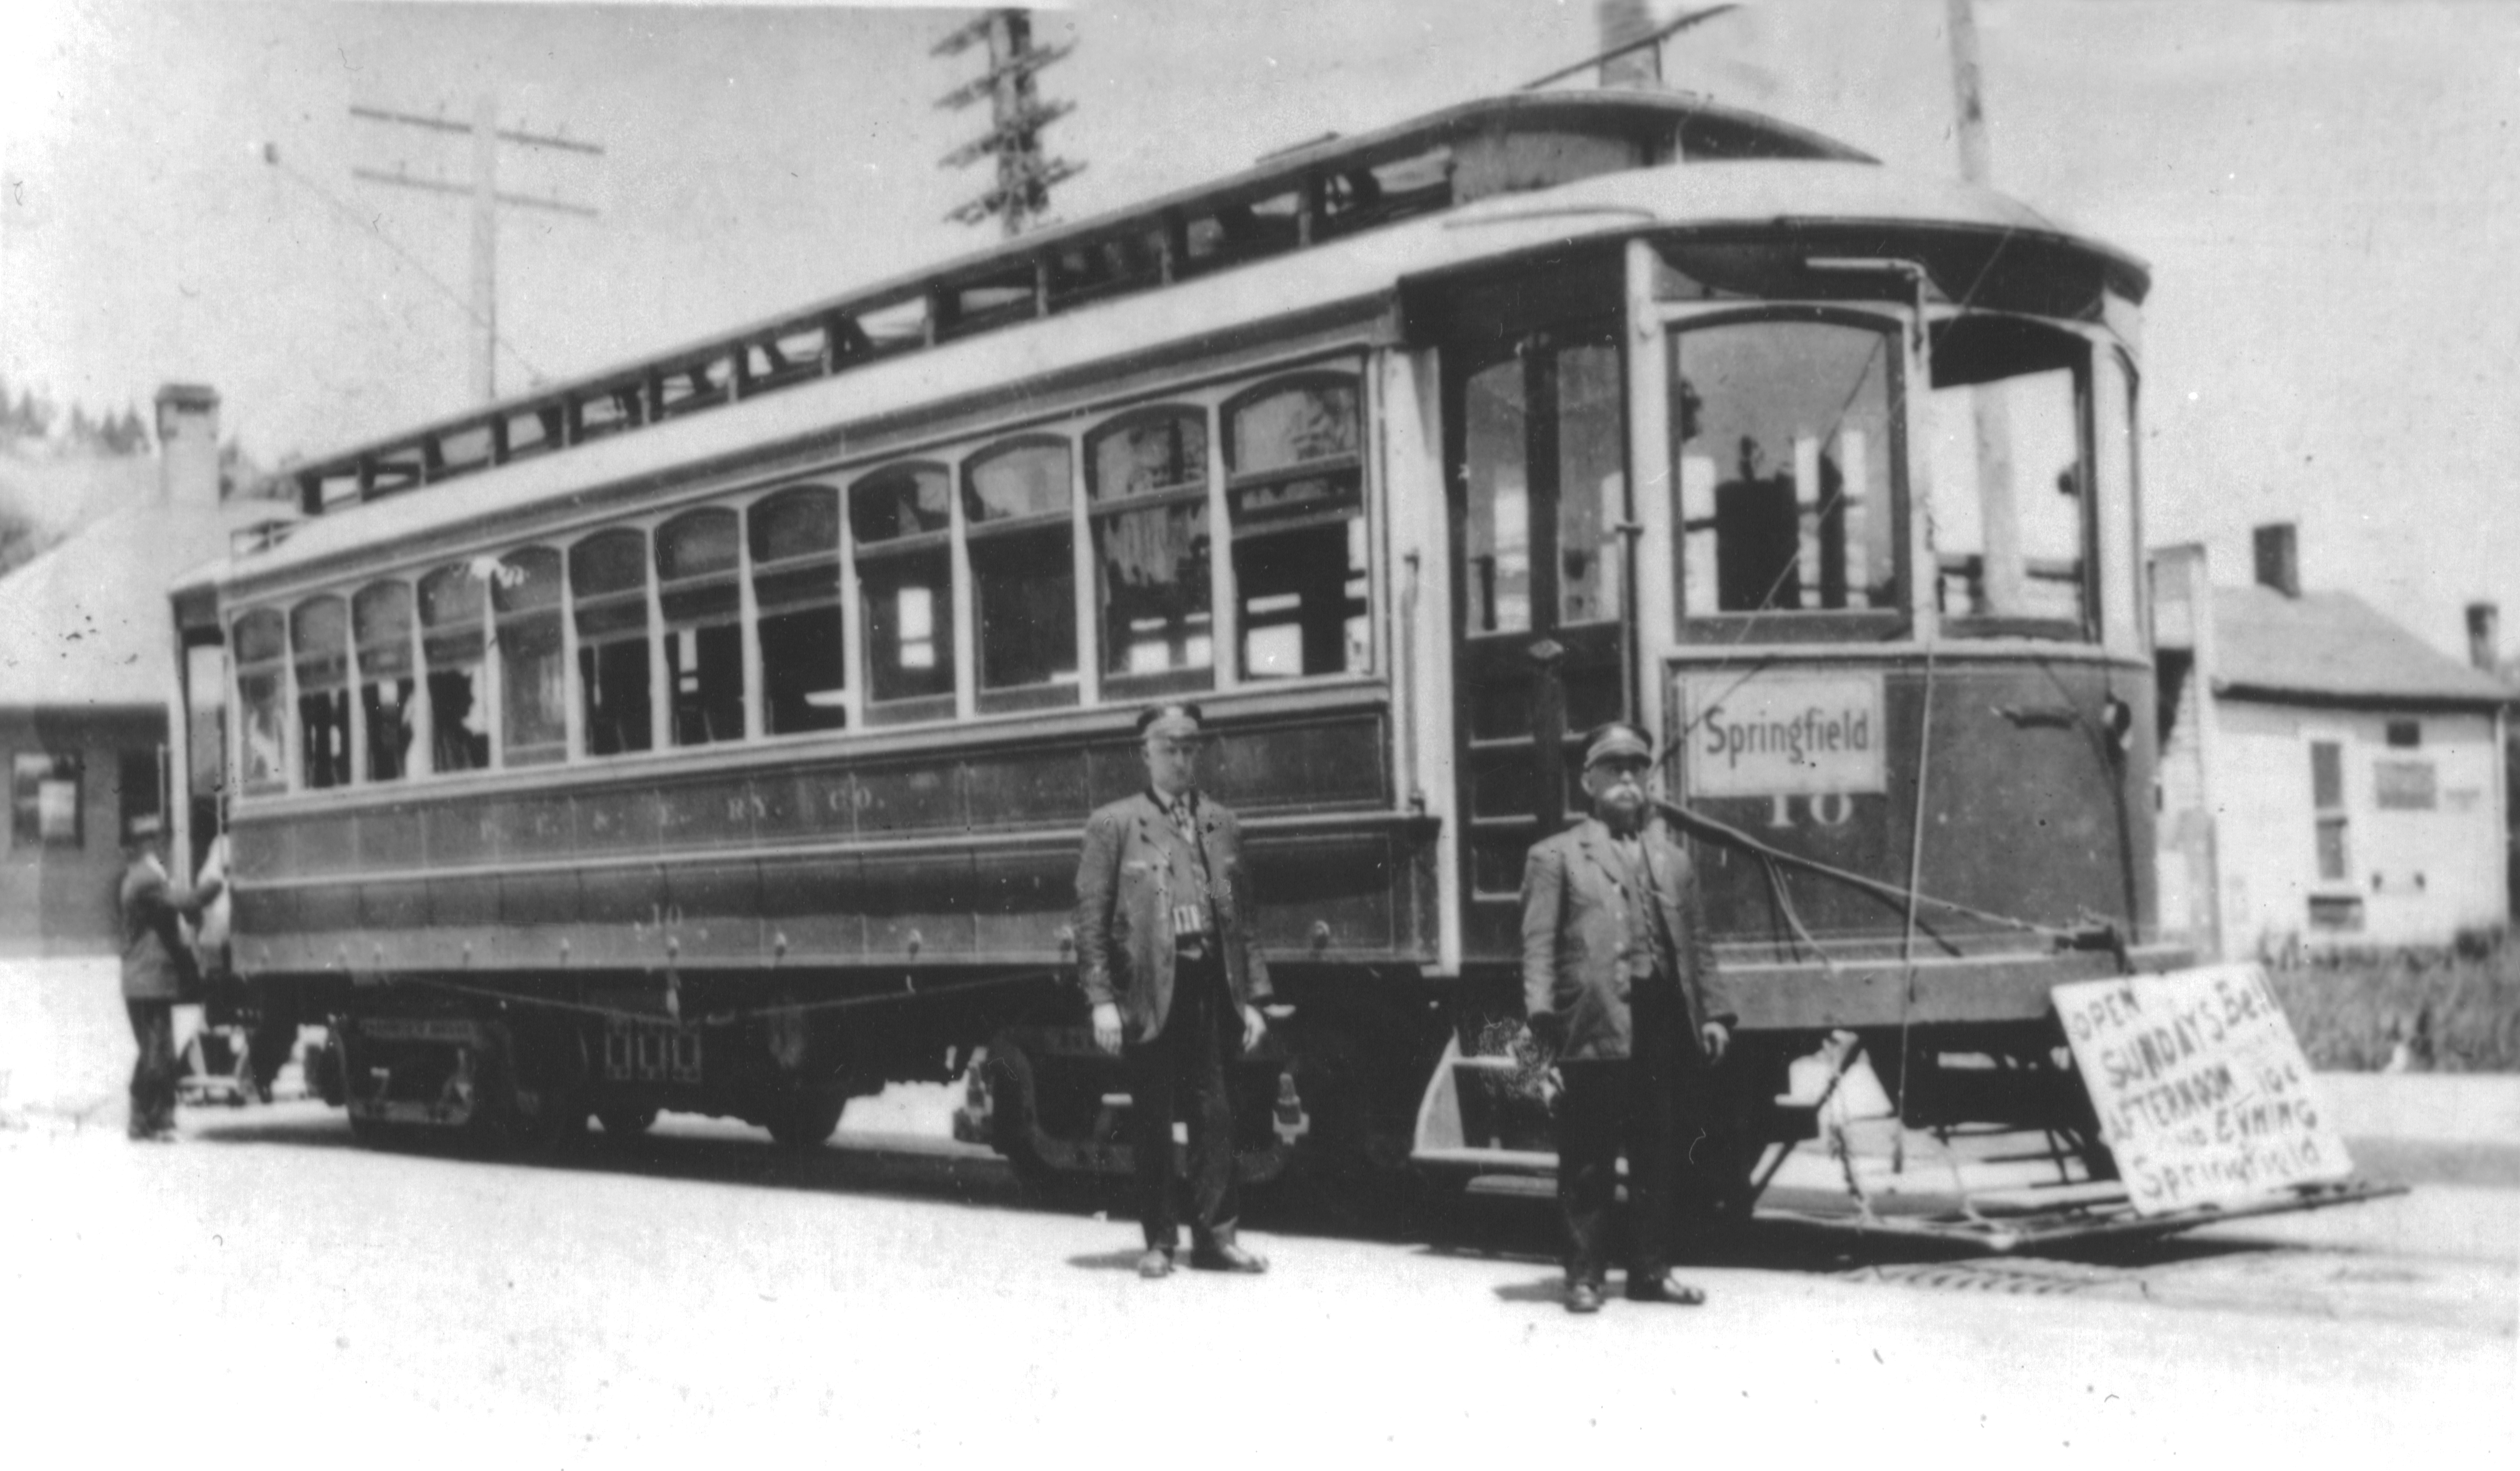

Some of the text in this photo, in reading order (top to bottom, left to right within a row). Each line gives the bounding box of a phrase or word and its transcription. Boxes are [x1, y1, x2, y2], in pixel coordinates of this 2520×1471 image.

[1705, 706, 1868, 769] Springfield
[829, 786, 884, 811] CO.
[1768, 794, 1853, 828] 10
[2073, 989, 2141, 1041] OPEN
[2102, 999, 2225, 1089] SUNDAYS
[2107, 1062, 2235, 1141] AFTERNOON
[2133, 1139, 2320, 1201] Springfield
